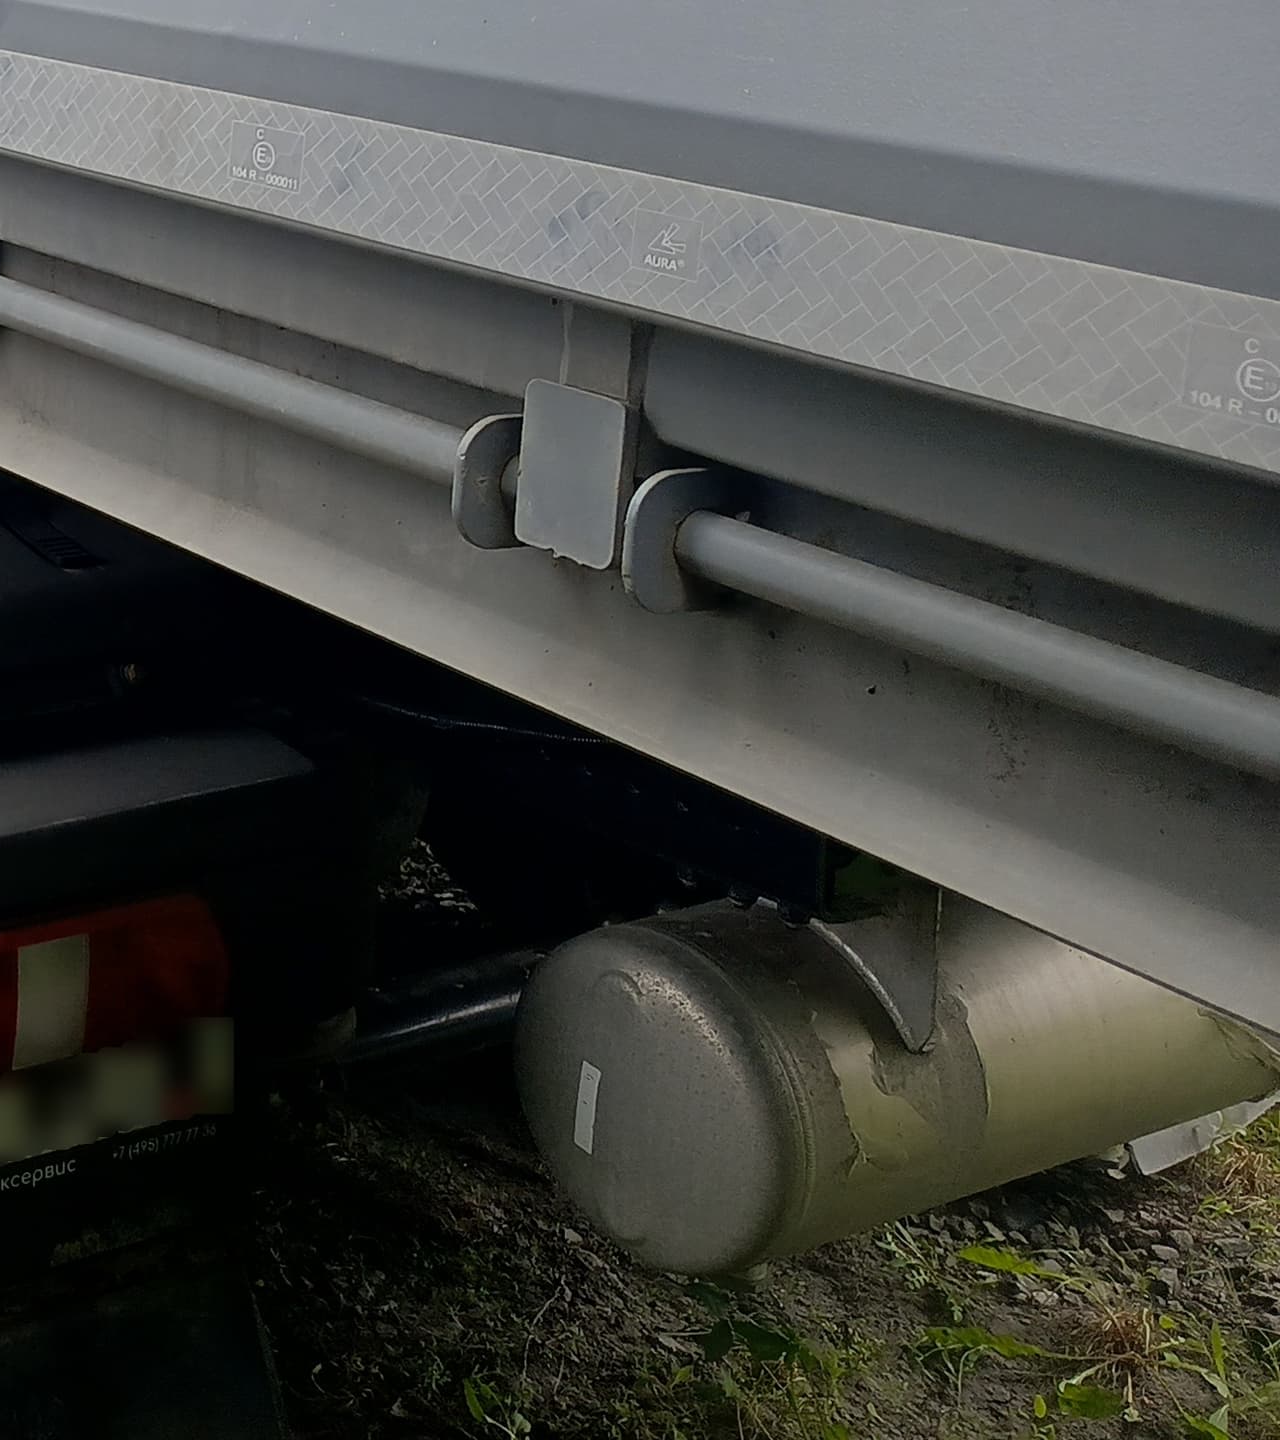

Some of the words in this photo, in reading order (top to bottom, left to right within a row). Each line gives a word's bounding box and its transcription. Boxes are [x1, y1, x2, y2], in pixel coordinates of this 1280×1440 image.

[256, 129, 265, 140] C
[232, 166, 247, 179] 104
[249, 170, 257, 181] R
[265, 174, 297, 190] 000011
[644, 254, 677, 272] AURA
[1245, 337, 1261, 354] C
[1190, 390, 1222, 409] 104
[1228, 398, 1243, 416] R
[1265, 407, 1280, 424] 0
[128, 1137, 159, 1160] (495)
